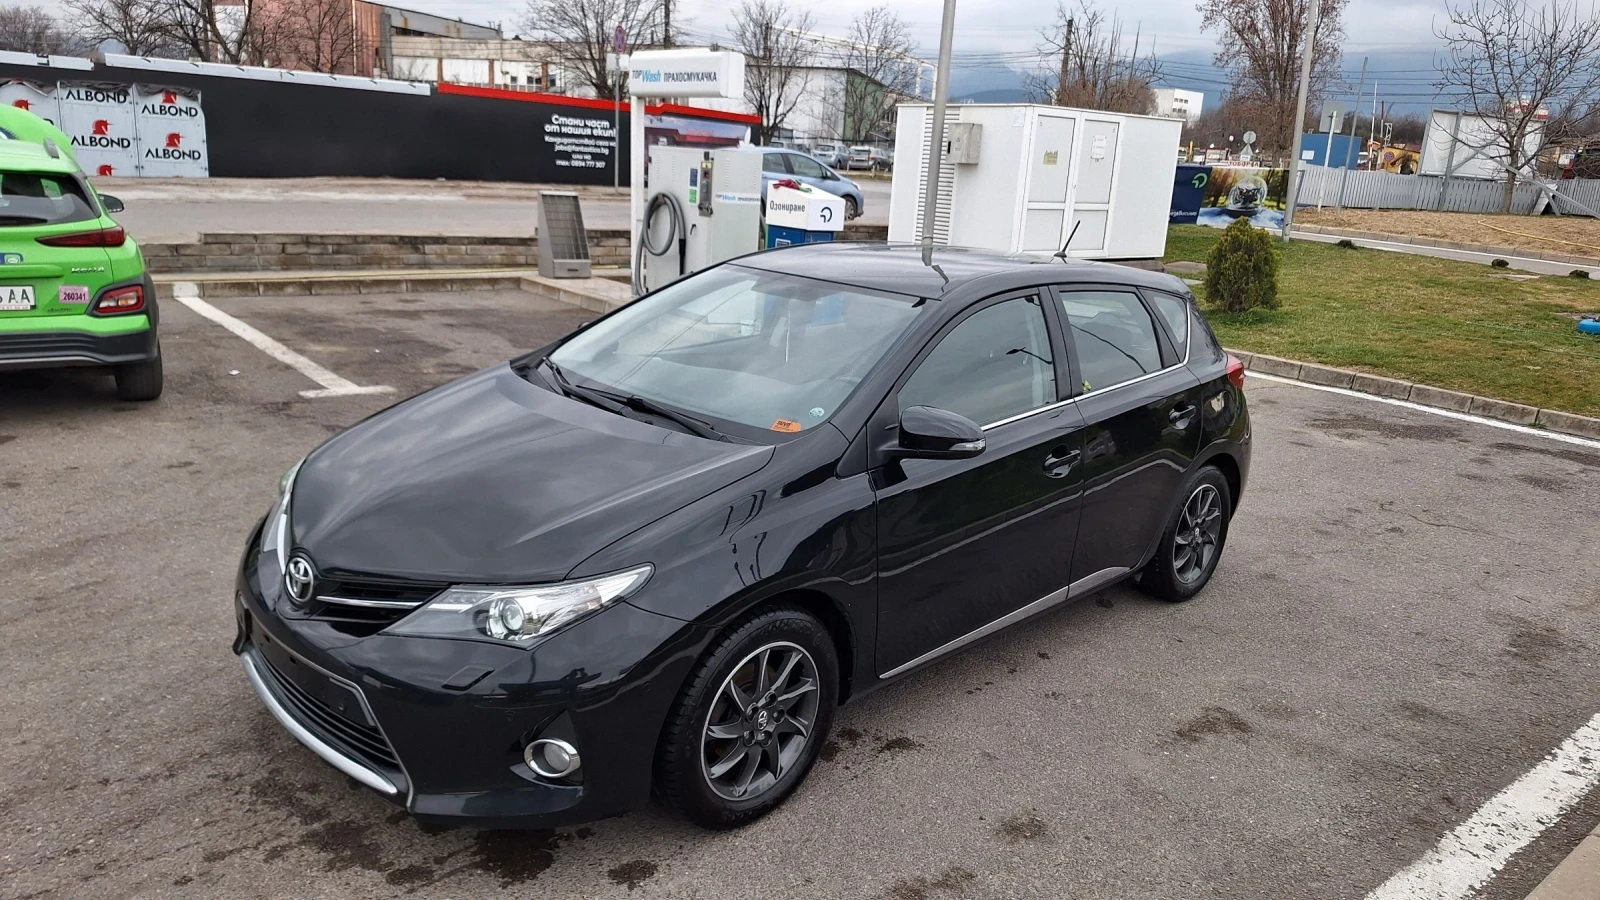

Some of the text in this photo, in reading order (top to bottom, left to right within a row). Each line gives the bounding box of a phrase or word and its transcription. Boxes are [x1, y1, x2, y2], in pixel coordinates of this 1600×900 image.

[663, 71, 717, 82] ПРАХОСМУКАЧКА
[65, 89, 127, 104] ALBOND
[141, 103, 198, 117] ALBOND
[551, 114, 610, 129] Стани част
[544, 123, 560, 133] от
[561, 126, 592, 136] нашия
[70, 135, 131, 149] ALBOND
[145, 148, 201, 160] ALBOND
[769, 200, 806, 213] Озониране
[63, 292, 86, 301] 260341
